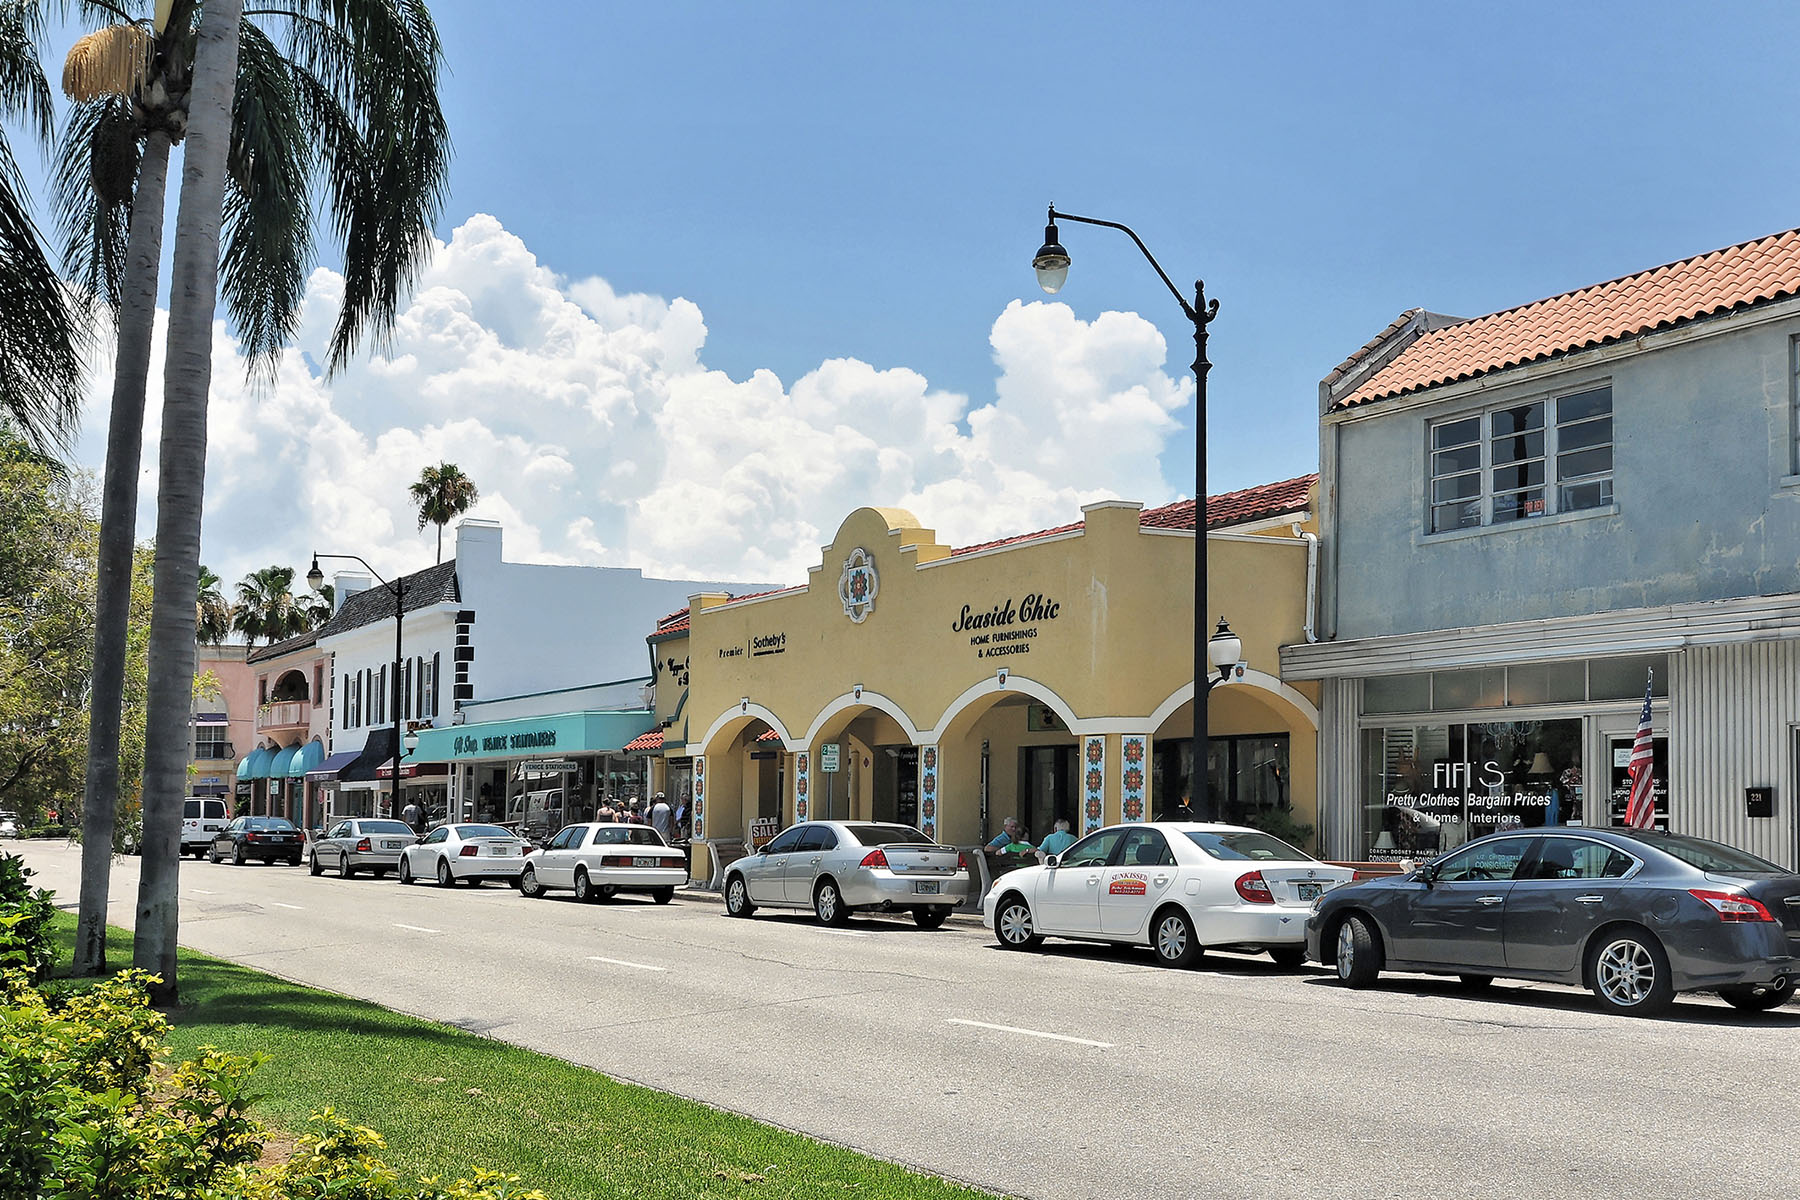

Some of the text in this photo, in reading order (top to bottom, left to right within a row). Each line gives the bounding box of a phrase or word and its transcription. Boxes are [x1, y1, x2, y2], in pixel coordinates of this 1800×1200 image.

[952, 594, 1060, 633] Seaside Chic
[753, 632, 786, 649] Sotheby's
[970, 627, 1038, 646] HOME FURNISHINGS
[719, 646, 744, 658] Premier
[978, 643, 1030, 658] & ACCESSORIES
[482, 735, 508, 751] VENICE
[510, 730, 556, 749] STATIONERS
[1433, 761, 1505, 788] FIFI'S
[1386, 793, 1552, 810] Pretty Clothes Bargain Prices
[1751, 793, 1762, 801] 221
[1413, 812, 1521, 824] & Home Interiors
[752, 825, 778, 837] SALE
